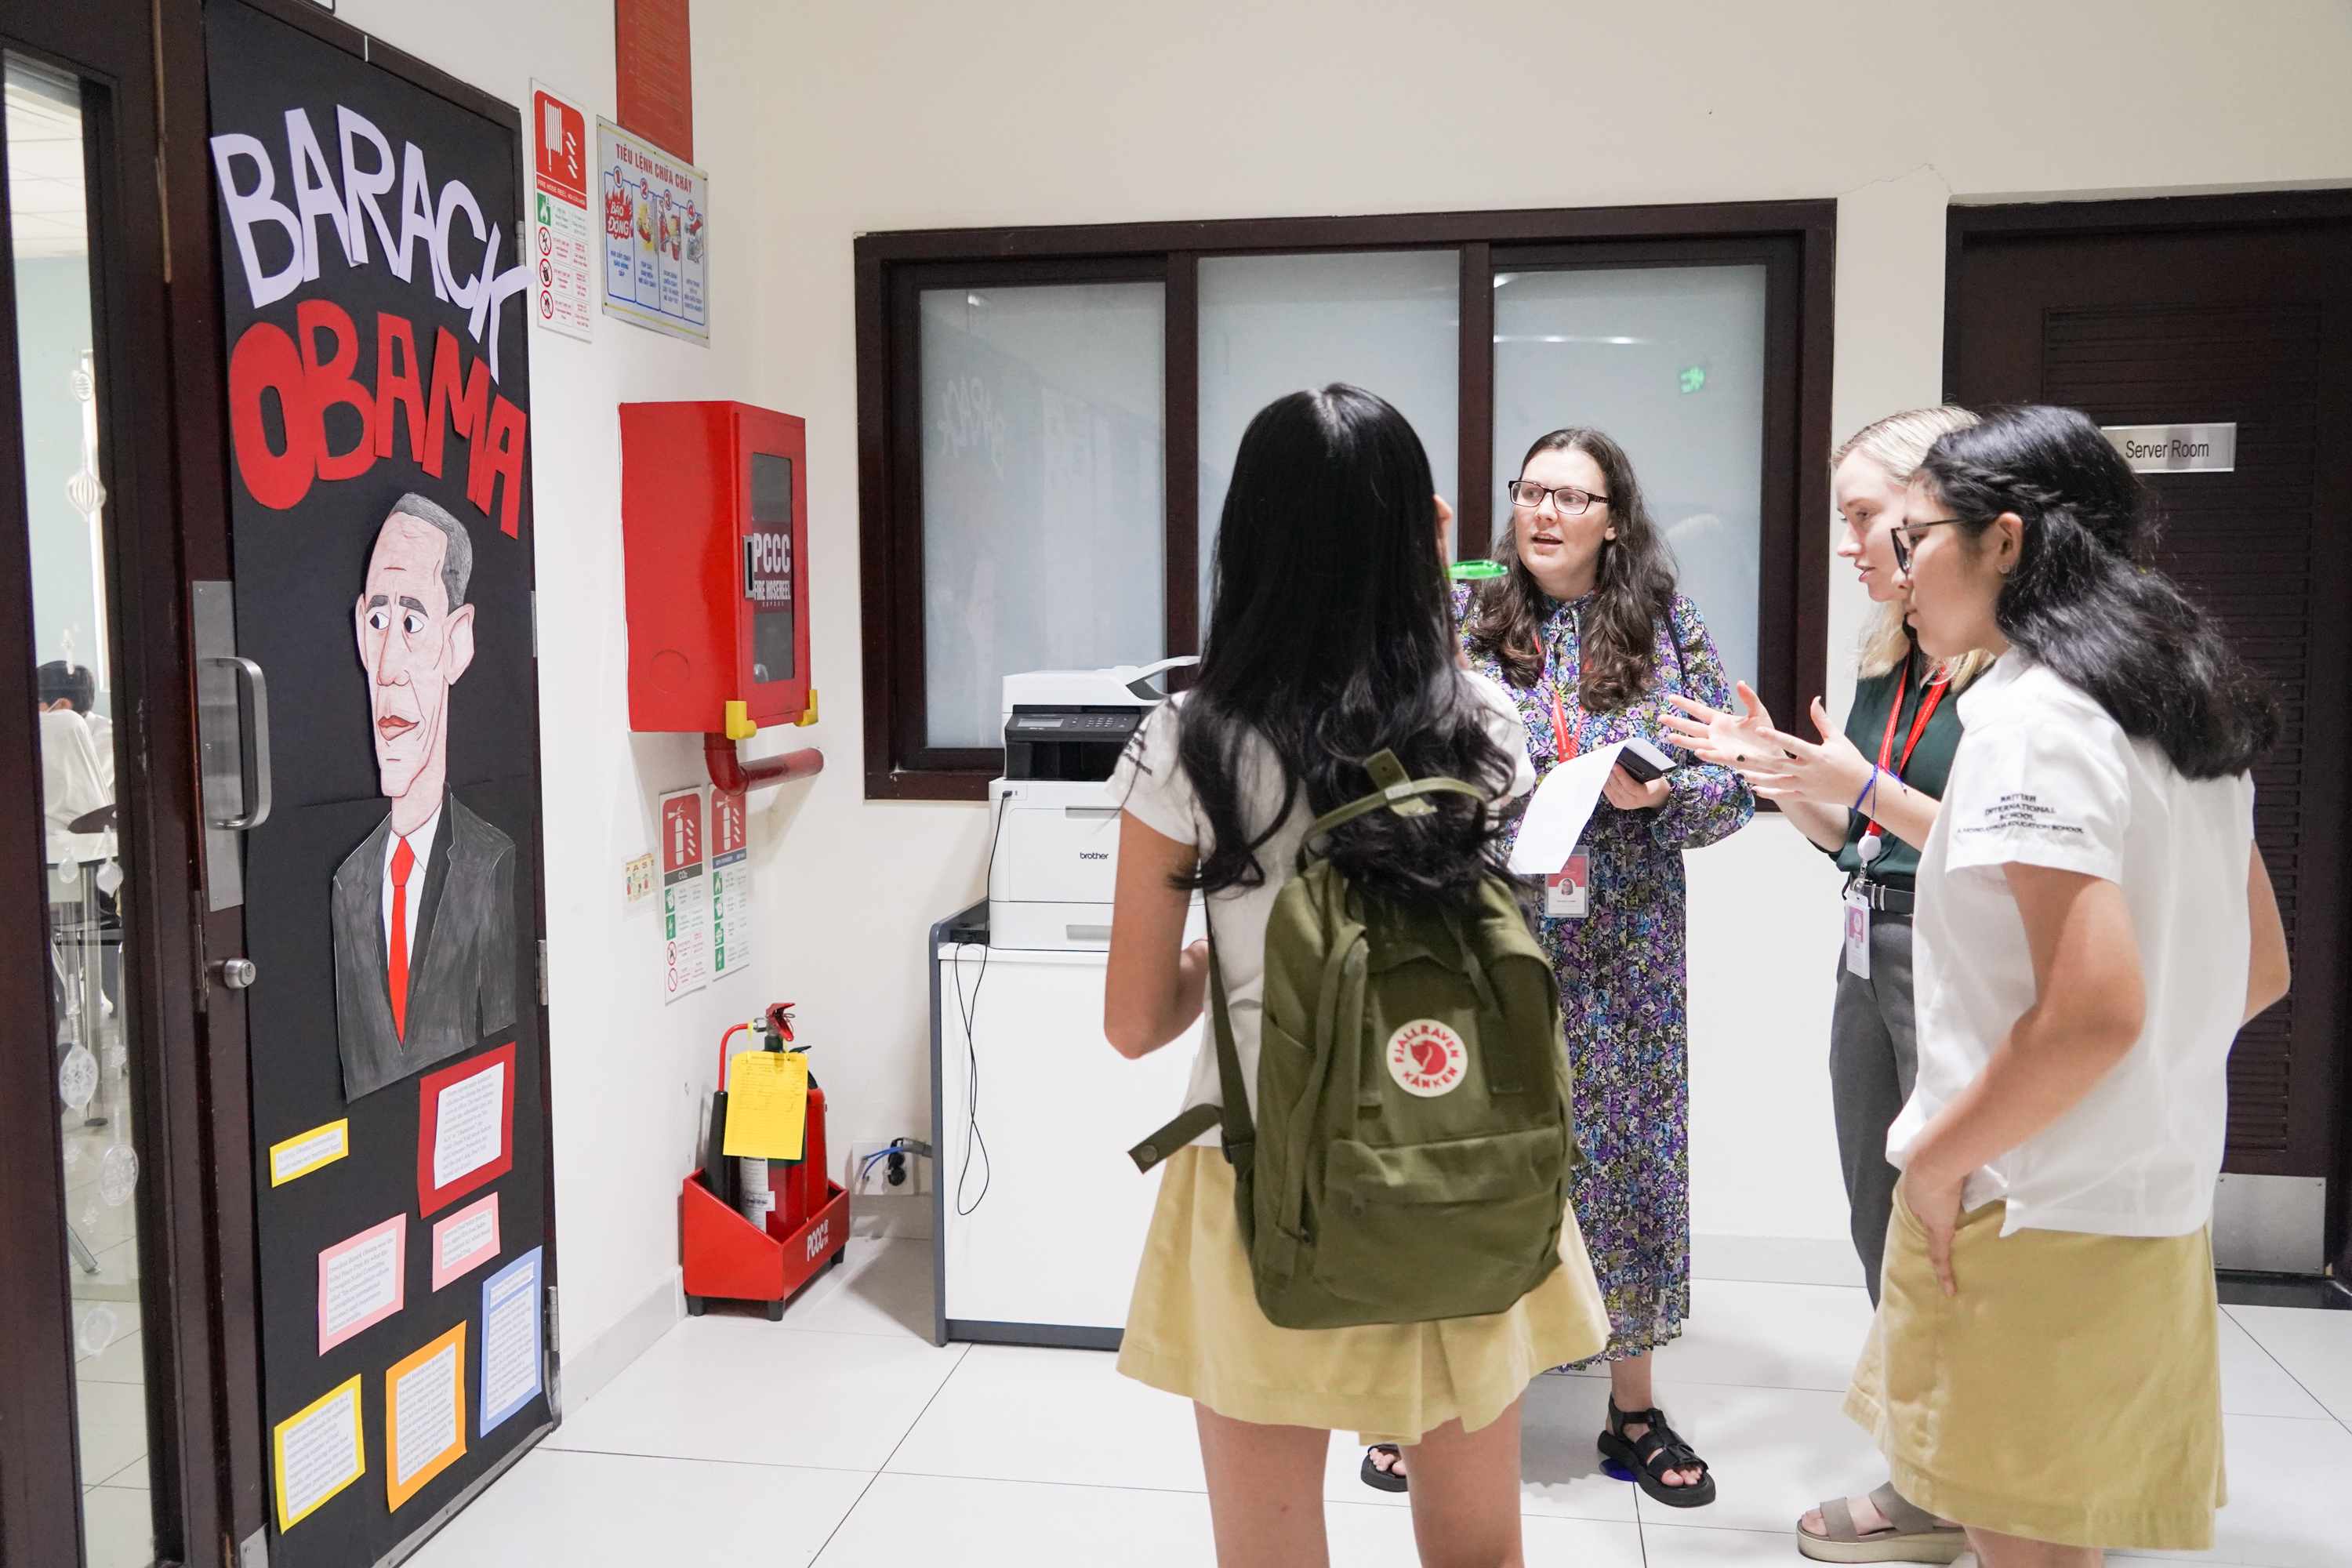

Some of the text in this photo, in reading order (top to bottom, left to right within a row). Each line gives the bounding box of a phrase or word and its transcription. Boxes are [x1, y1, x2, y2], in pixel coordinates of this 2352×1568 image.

[211, 104, 536, 384] BARACK
[230, 299, 527, 539] OBAMA
[2125, 439, 2209, 459] Server Room
[753, 533, 791, 573] PCCC
[1985, 804, 2056, 816] INTERNATIONAL
[1998, 812, 2036, 821] SCHOOL
[807, 1222, 824, 1261] PCCC
